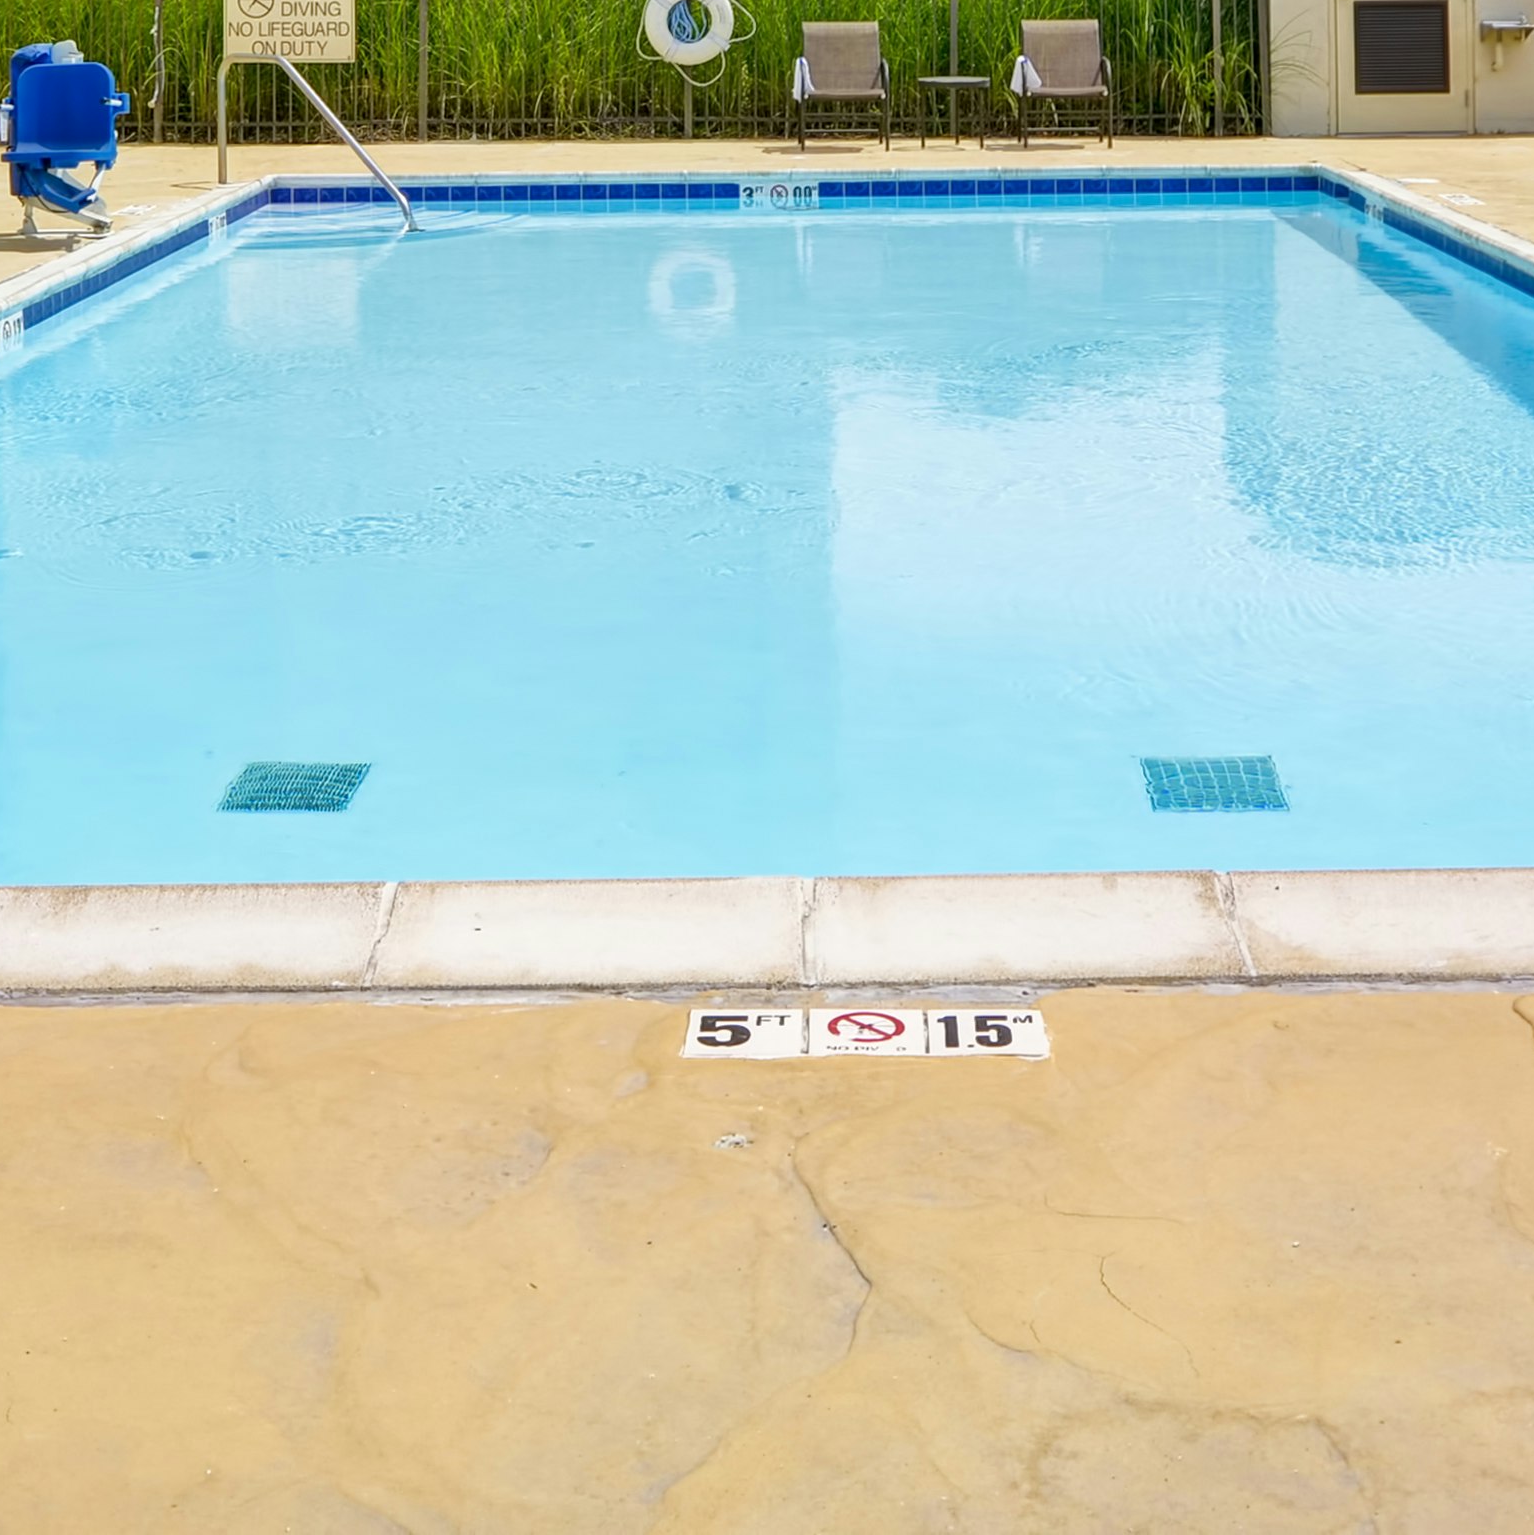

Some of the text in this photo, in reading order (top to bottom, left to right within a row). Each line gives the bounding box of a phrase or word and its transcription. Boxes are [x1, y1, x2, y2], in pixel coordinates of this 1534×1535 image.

[281, 1, 342, 17] DIVING
[228, 21, 350, 38] NO LIFEGUARD
[252, 40, 328, 57] ON DUTY
